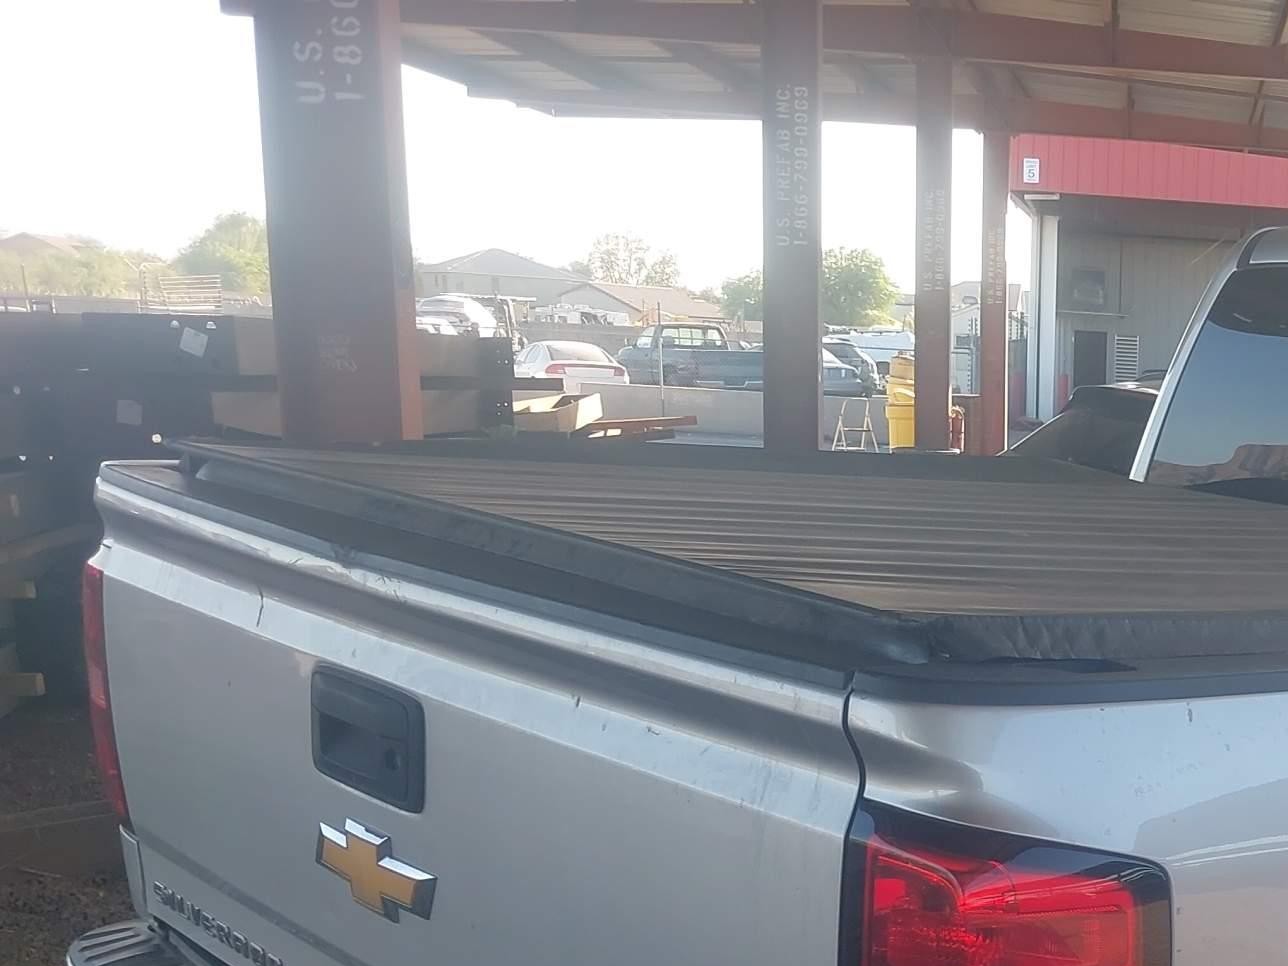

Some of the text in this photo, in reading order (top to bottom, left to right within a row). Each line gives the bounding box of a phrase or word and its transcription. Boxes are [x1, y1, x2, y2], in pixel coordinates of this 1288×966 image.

[775, 83, 791, 247] U.S. PREFAB INC.
[1027, 168, 1036, 178] 5
